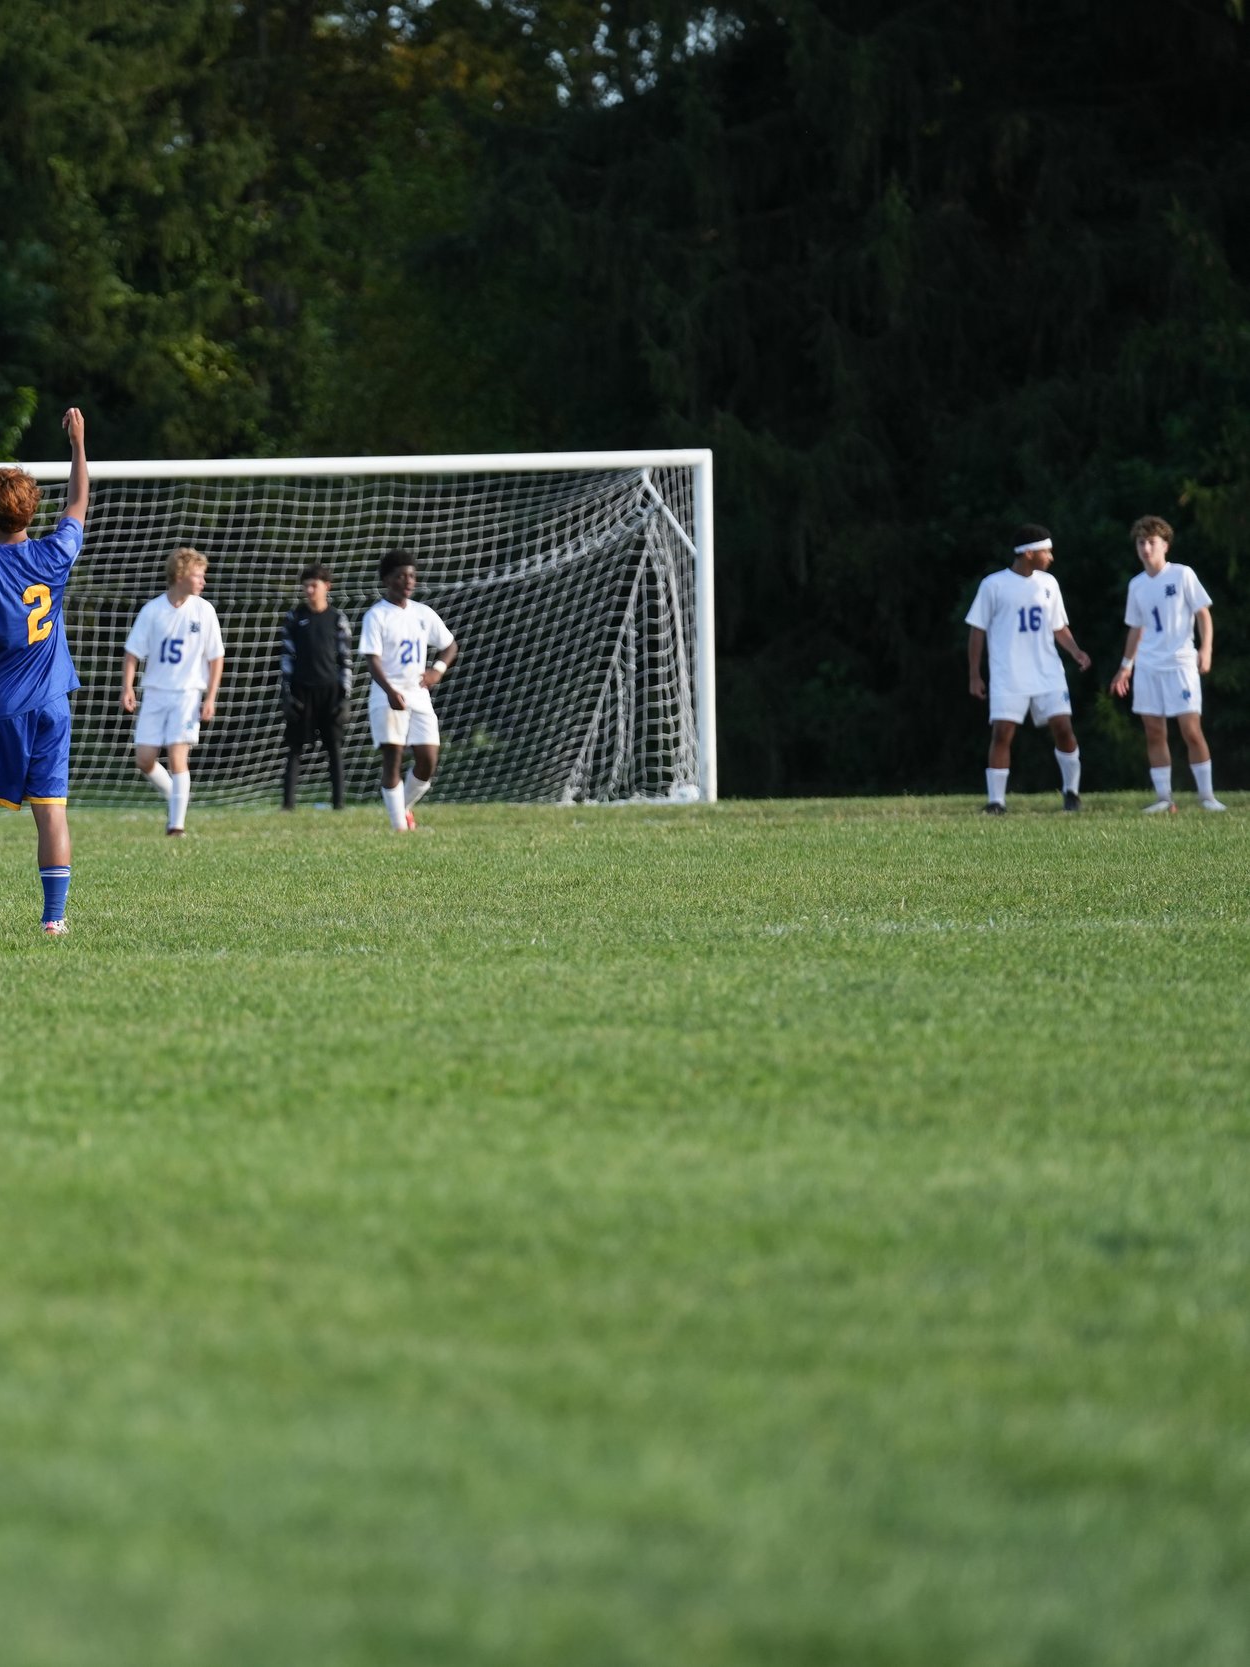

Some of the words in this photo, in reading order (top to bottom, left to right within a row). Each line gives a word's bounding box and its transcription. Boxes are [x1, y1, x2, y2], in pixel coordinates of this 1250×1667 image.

[22, 583, 53, 646] 2
[1018, 606, 1042, 632] 16
[1152, 605, 1162, 632] 1
[160, 637, 184, 664] 15
[400, 638, 420, 665] 21
